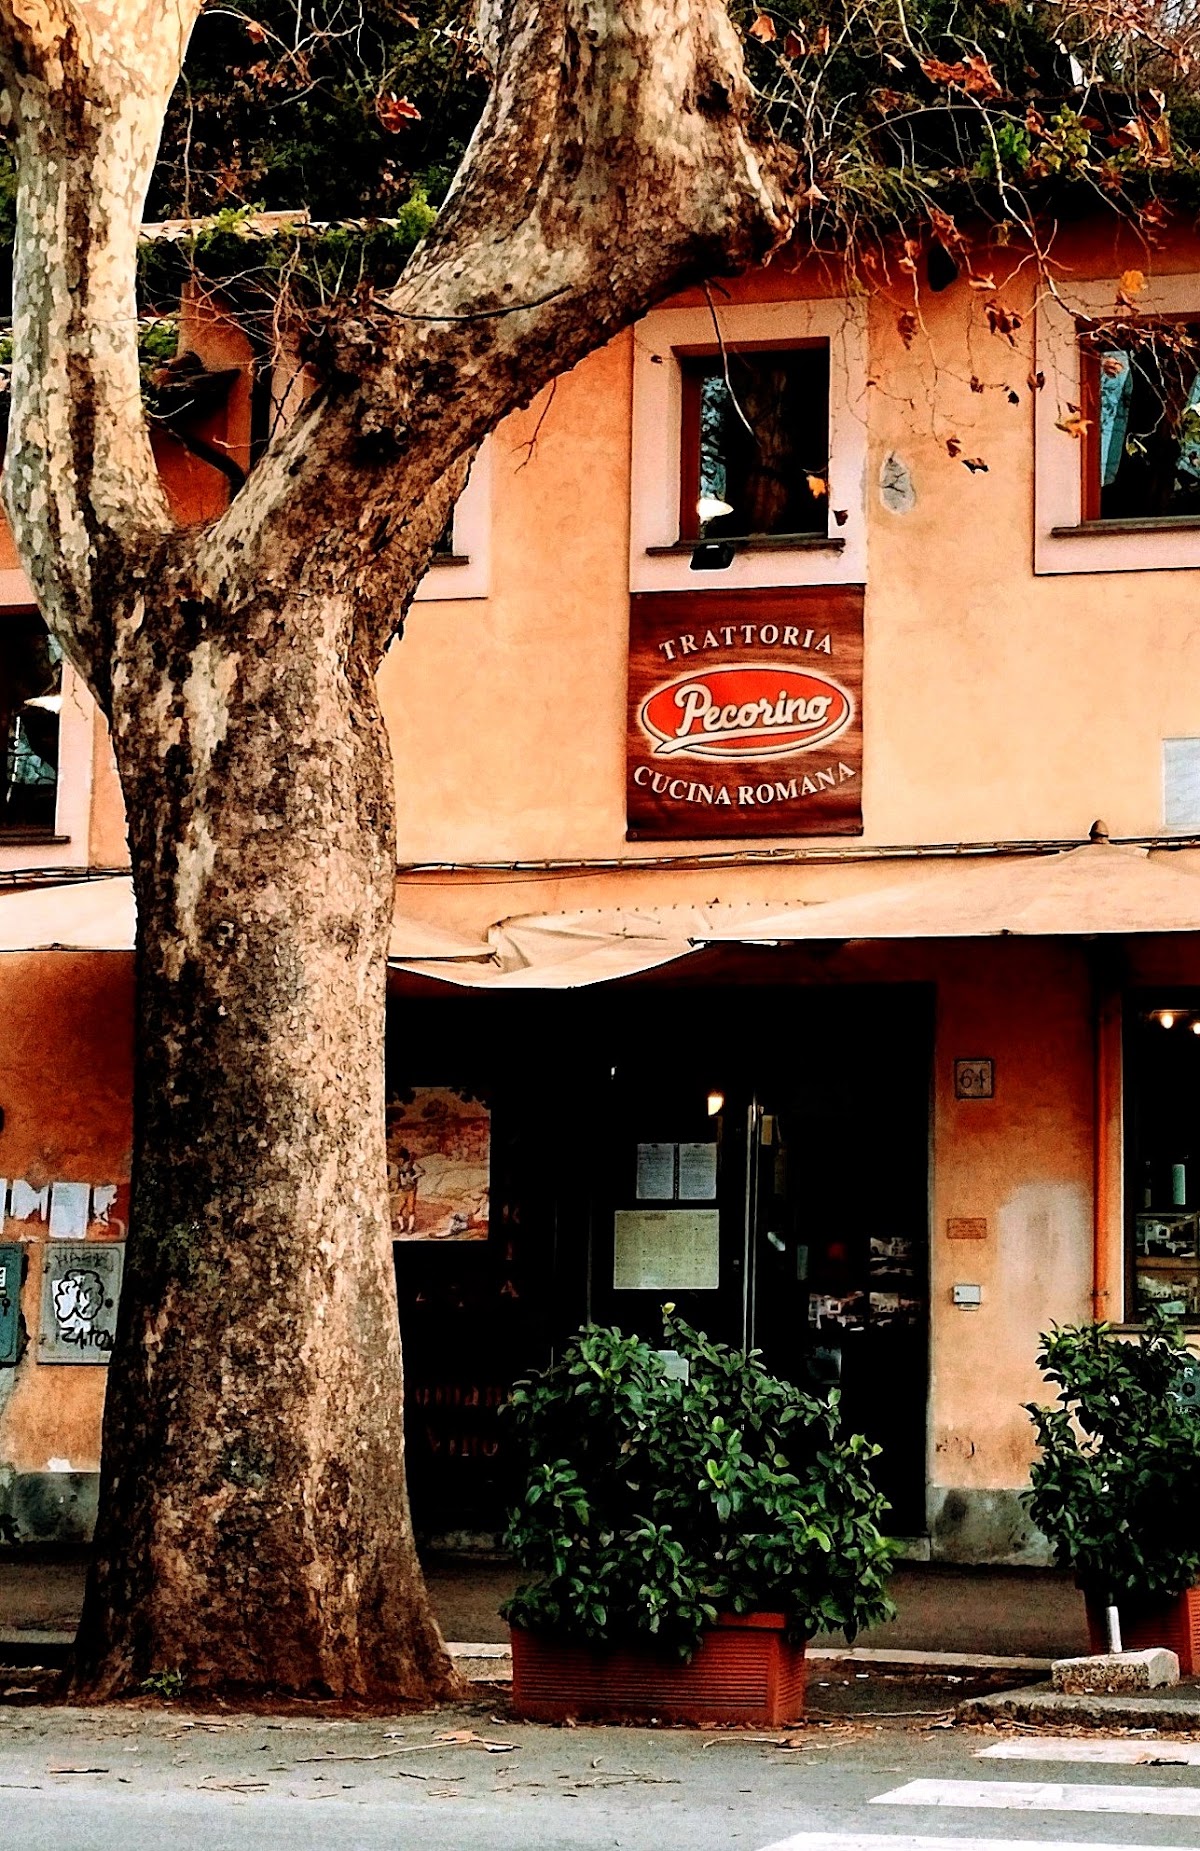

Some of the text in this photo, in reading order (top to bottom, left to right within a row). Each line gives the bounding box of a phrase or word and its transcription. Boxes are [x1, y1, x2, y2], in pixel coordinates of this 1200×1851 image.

[659, 624, 832, 660] TRATTORIA
[674, 683, 833, 738] Pecorino
[633, 761, 856, 805] CUCINA ROMANA
